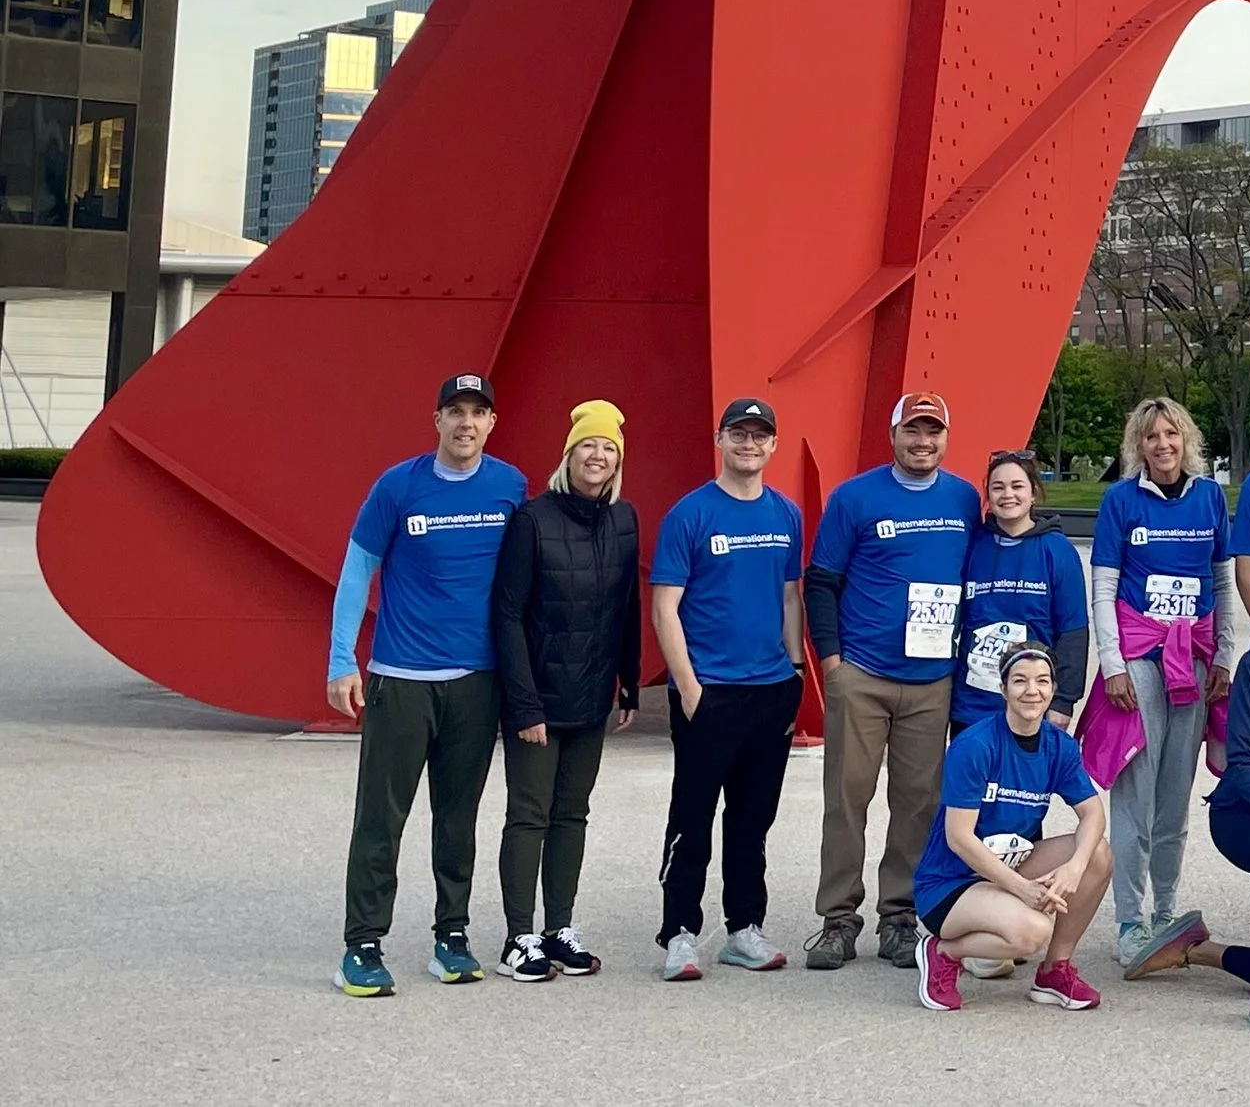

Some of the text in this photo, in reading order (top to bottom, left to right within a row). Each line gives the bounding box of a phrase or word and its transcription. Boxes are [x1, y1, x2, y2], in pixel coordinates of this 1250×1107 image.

[427, 512, 481, 525] international
[895, 518, 944, 529] international
[1148, 529, 1196, 537] international
[1197, 528, 1214, 536] need
[1025, 581, 1047, 590] needs
[1149, 593, 1197, 616] 25316
[910, 601, 957, 624] 25300
